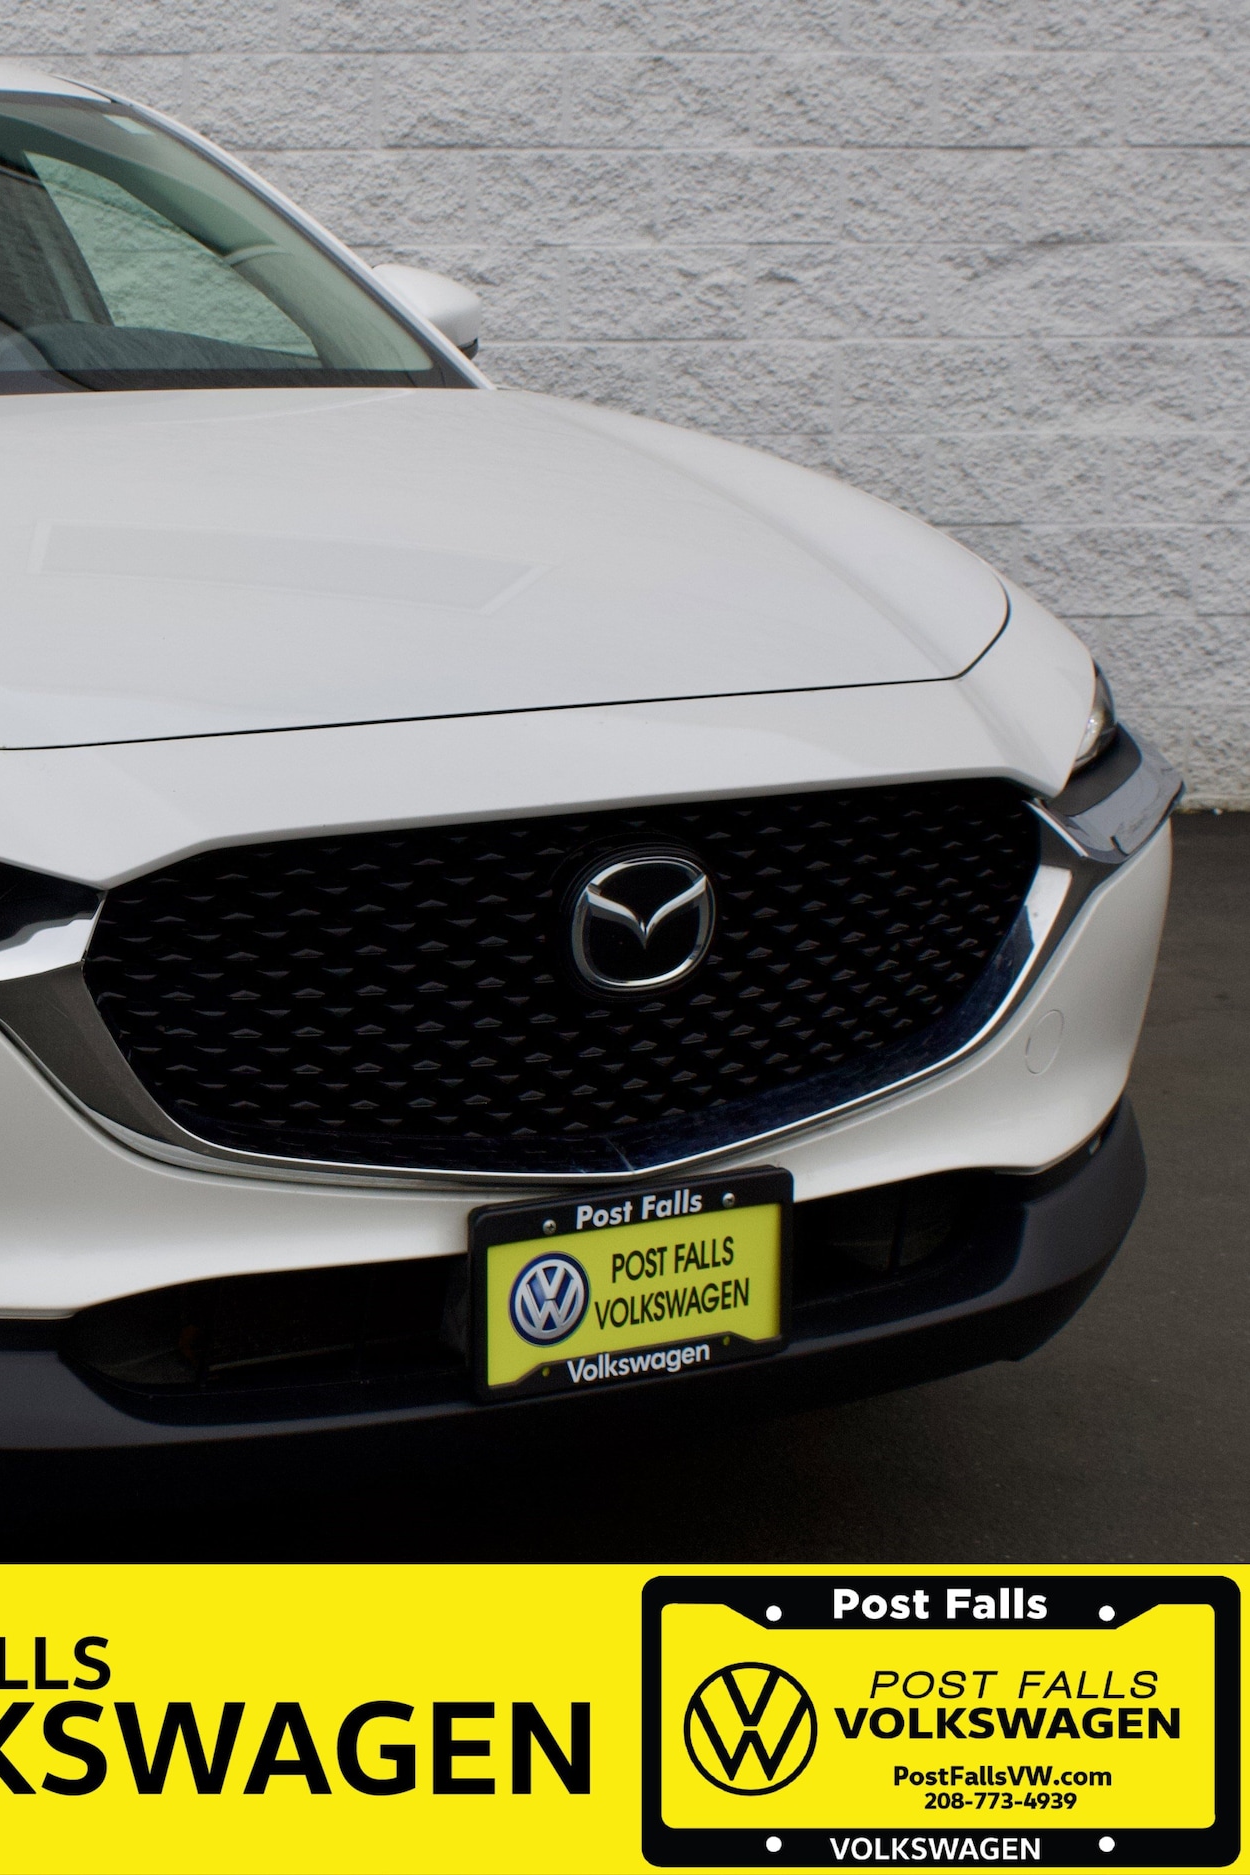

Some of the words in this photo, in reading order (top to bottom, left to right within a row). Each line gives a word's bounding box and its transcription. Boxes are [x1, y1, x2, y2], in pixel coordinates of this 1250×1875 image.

[576, 1203, 633, 1230] Post
[641, 1189, 702, 1220] Falls
[611, 1246, 668, 1284] POST
[674, 1235, 735, 1274] FALLS
[594, 1277, 750, 1330] VOLKSWAGEN
[566, 1343, 711, 1384] Volkswagen
